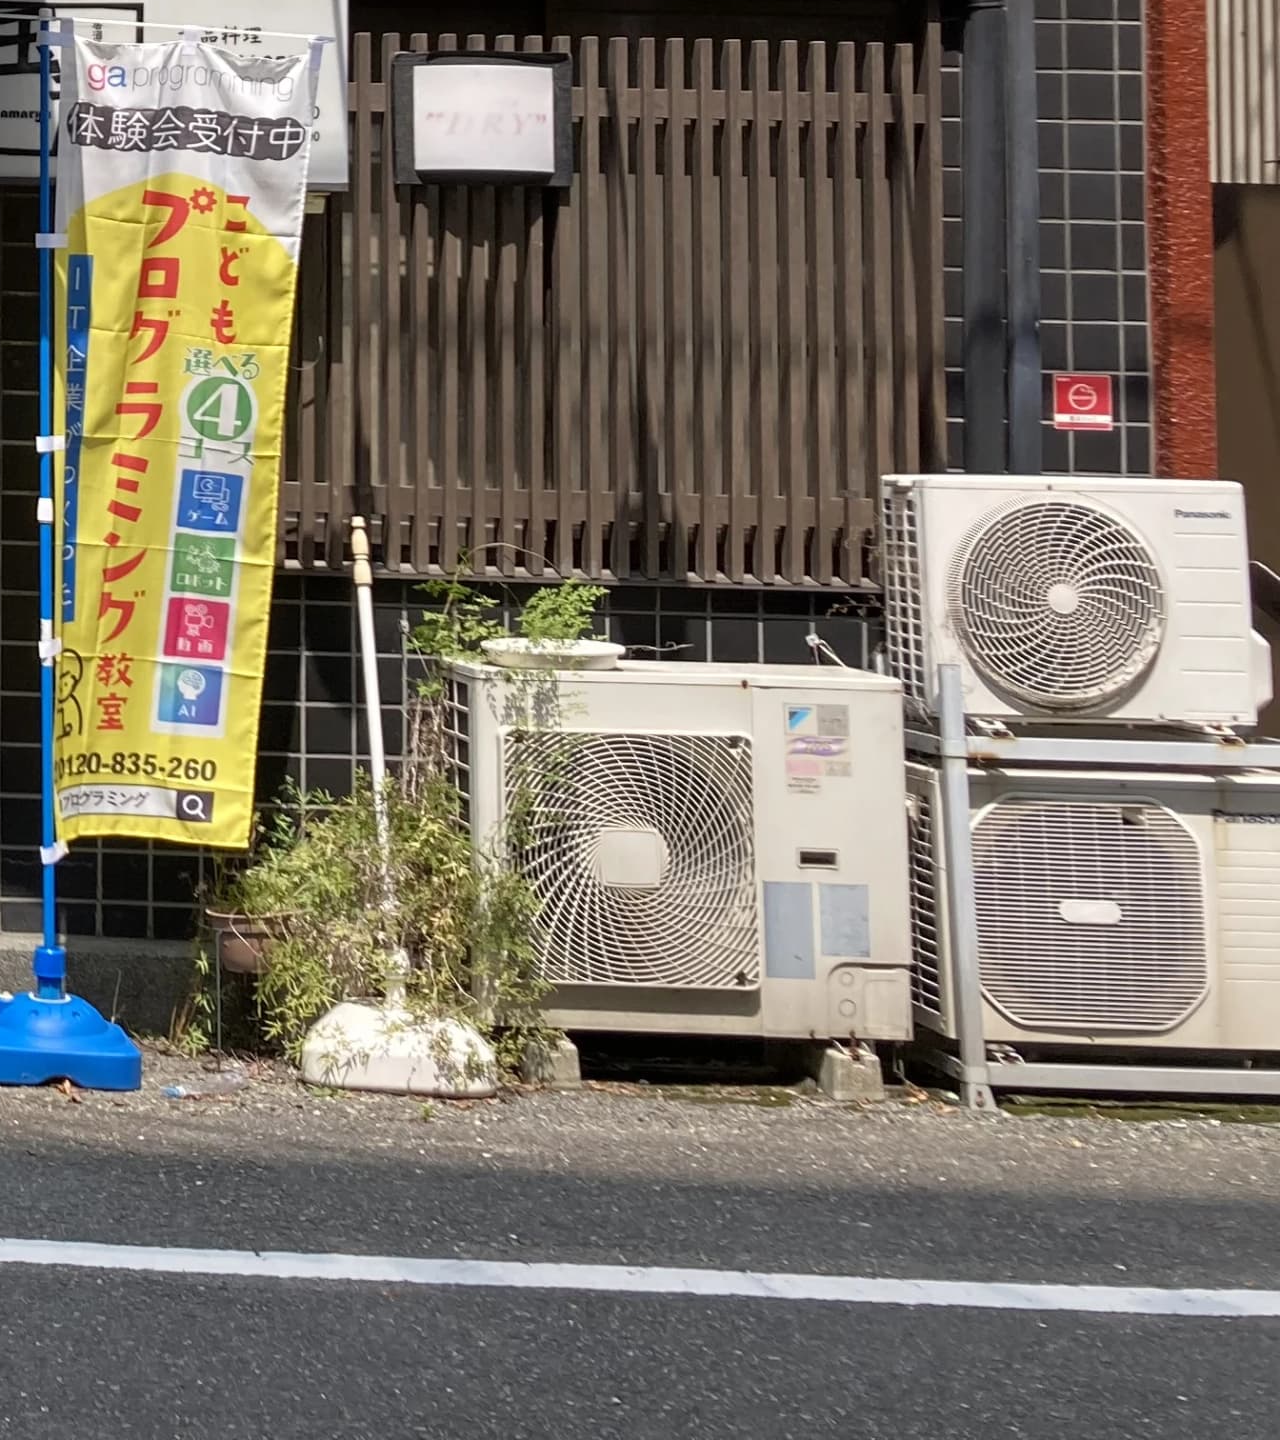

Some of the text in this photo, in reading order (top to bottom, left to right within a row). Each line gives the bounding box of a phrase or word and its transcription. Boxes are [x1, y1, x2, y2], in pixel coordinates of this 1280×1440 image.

[87, 60, 294, 102] ga programming
[69, 102, 305, 158] 体験会受付中
[210, 196, 251, 345] こども
[183, 347, 260, 380] 選べる
[193, 383, 242, 437] 4
[187, 509, 228, 525] ゲーム
[1174, 508, 1232, 520] Panasonic
[176, 572, 227, 591] ロボット
[178, 704, 196, 718] AI
[1212, 808, 1280, 824] Panaso
